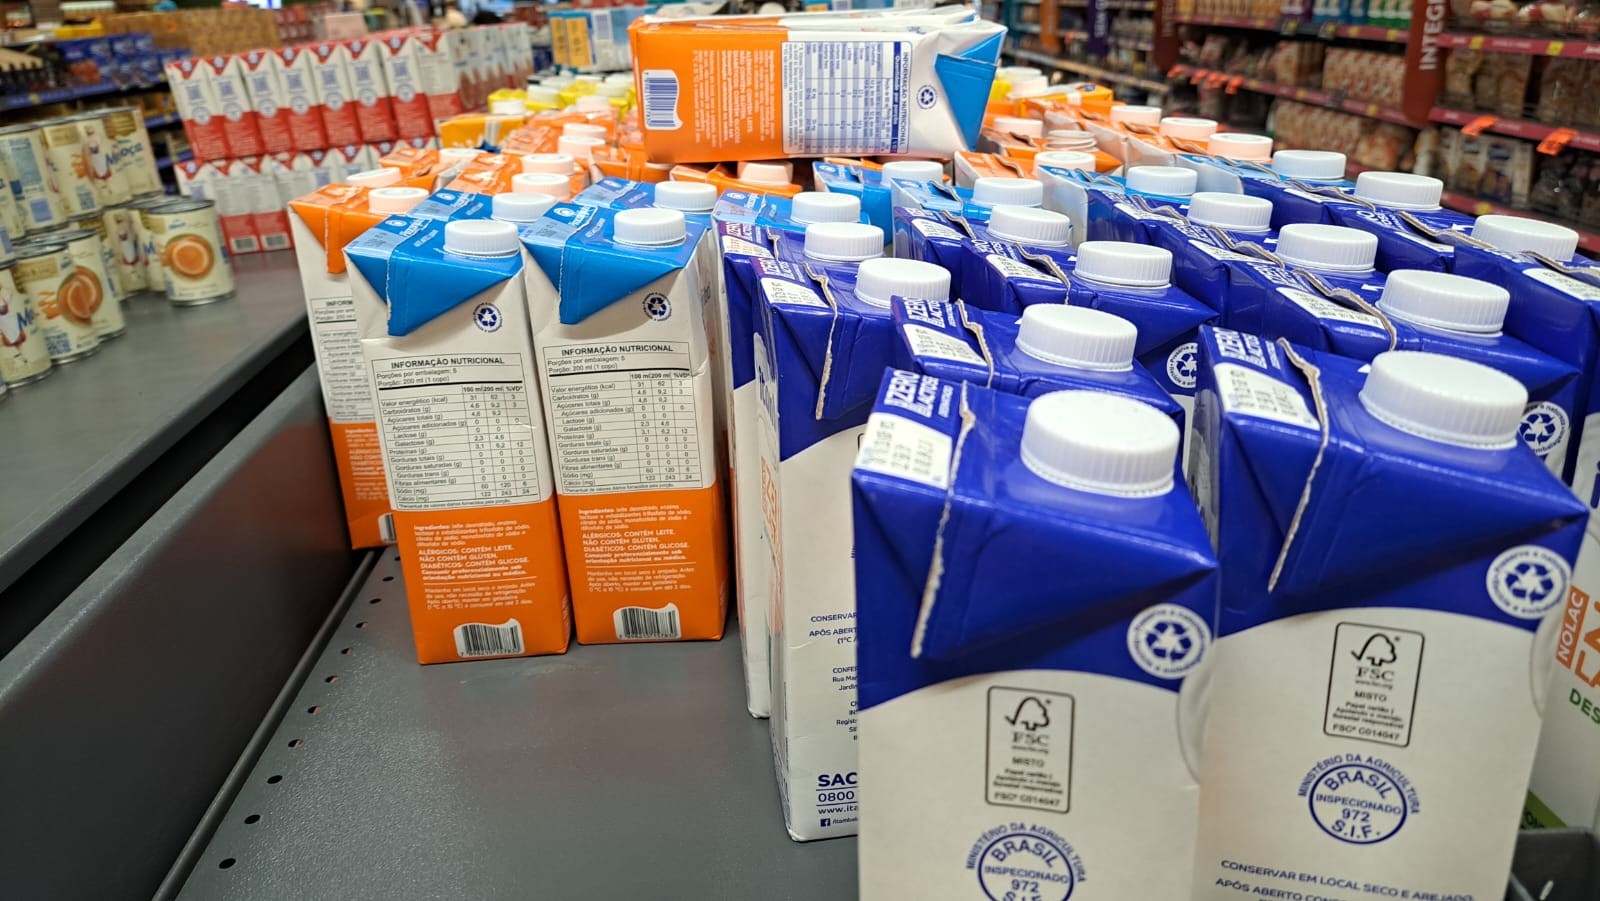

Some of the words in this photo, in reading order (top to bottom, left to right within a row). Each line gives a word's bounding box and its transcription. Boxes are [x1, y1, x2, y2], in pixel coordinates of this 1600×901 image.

[1419, 0, 1446, 70] INTEG
[562, 346, 617, 356] INFORMAÇÃO
[391, 358, 449, 369] INFORMAÇÃO
[450, 357, 505, 365] NUTRICIONAL
[376, 372, 401, 380] Porções
[378, 379, 400, 388] Porção:
[568, 385, 598, 393] energético
[399, 397, 430, 406] energético
[388, 415, 415, 423] Açúcares
[392, 423, 420, 431] Açúcares
[809, 629, 831, 637] APÓS
[1558, 592, 1584, 662] NOLAC
[1357, 666, 1394, 681] FSC
[1355, 690, 1387, 702] MISTO
[1013, 731, 1050, 746] FSC
[1012, 756, 1044, 768] MISTO
[818, 772, 857, 787] SAC
[1298, 754, 1343, 797] MINISTÉRIO
[1346, 753, 1362, 762] DA
[1366, 756, 1420, 814] AGRICULTURA
[1324, 770, 1392, 799] BRASIL
[818, 791, 855, 802] 0800
[1316, 794, 1402, 815] INSPECIONADO
[1342, 808, 1370, 822] 972
[1332, 819, 1380, 839] S.I.F.
[966, 824, 1007, 870] MINISTÉRIO
[1010, 822, 1026, 831] DA
[1030, 824, 1087, 883] AGRICULTURA
[990, 840, 1058, 868] BRASIL
[985, 865, 1068, 884] INSPECIONADO
[1221, 860, 1296, 880] CONSERVAR
[1299, 873, 1317, 883] EM
[1320, 876, 1360, 891] LOCAL
[1363, 883, 1398, 897] SECO
[1401, 890, 1410, 898] E
[1011, 878, 1039, 893] 972
[1216, 878, 1250, 892] APÓS
[1252, 886, 1302, 901] ABERTO
